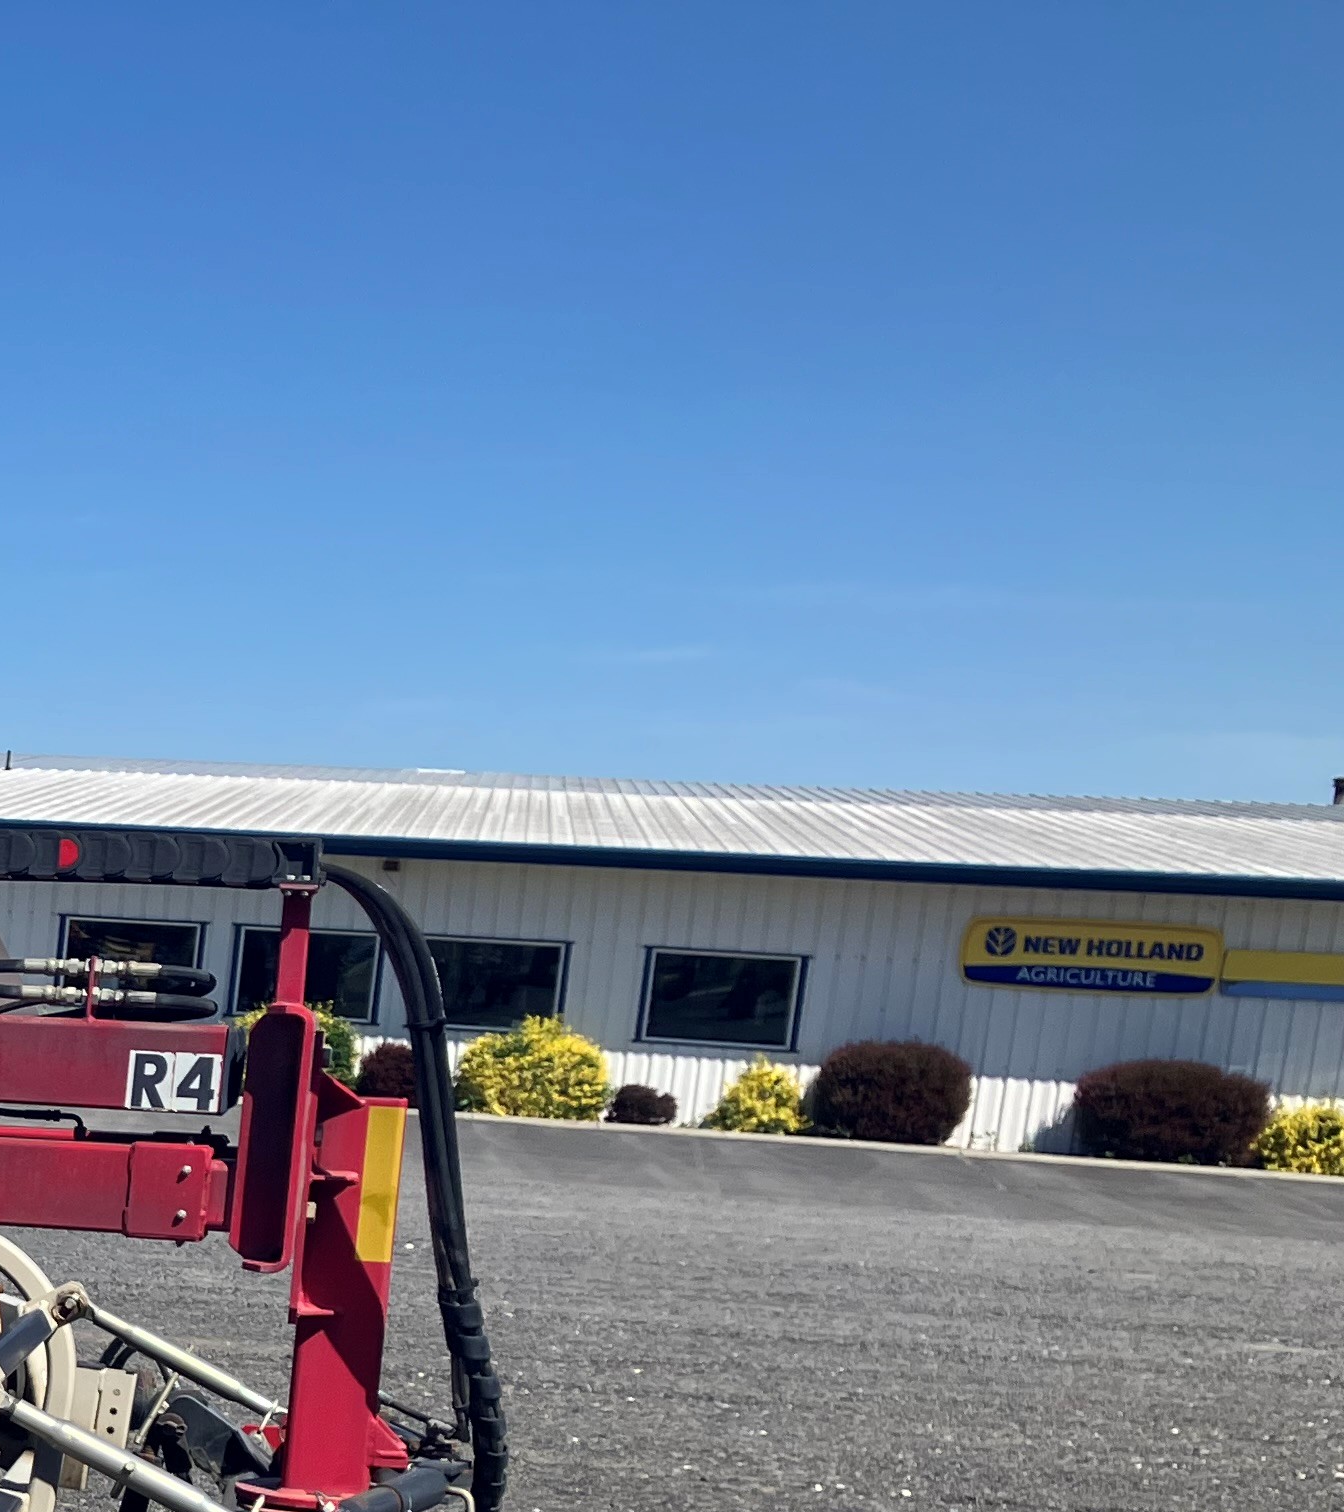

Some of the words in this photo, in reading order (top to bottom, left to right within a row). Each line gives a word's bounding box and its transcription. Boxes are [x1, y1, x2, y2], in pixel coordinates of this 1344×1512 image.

[1023, 935, 1080, 956] NEW
[1086, 939, 1204, 962] HOLLAND
[1016, 965, 1156, 989] AGRICULTURE
[131, 1053, 215, 1111] R4
